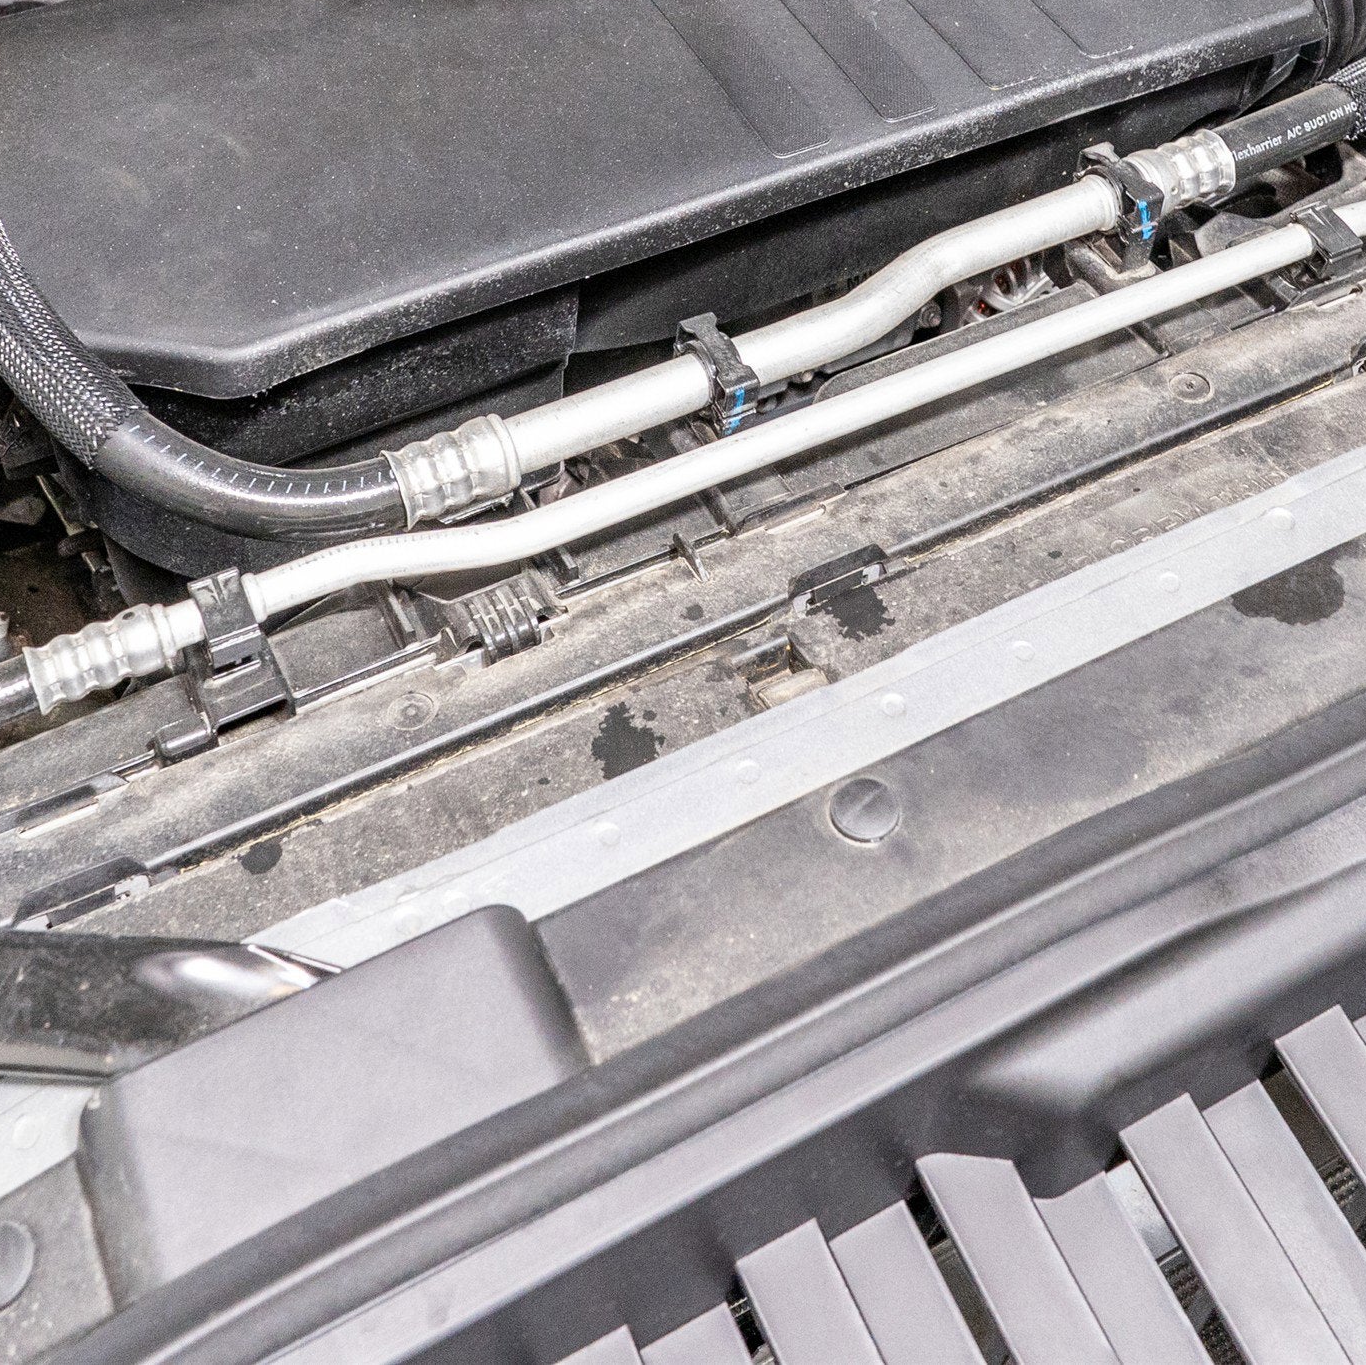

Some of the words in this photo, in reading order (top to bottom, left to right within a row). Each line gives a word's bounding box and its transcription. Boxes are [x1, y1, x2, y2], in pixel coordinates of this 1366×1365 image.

[1232, 135, 1283, 162] lexbarrier
[1286, 125, 1303, 141] A/C
[1303, 108, 1345, 132] SUCTION
